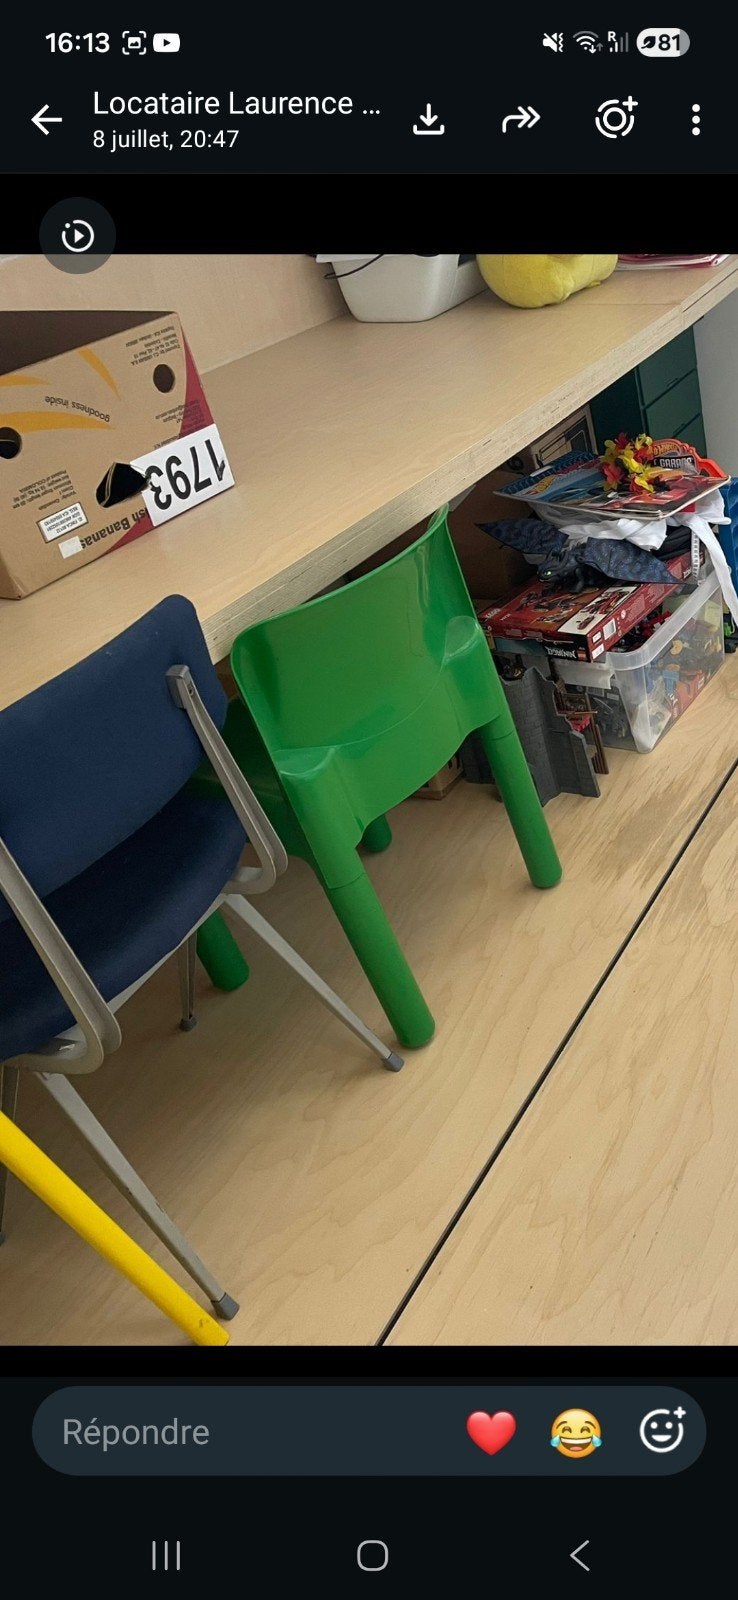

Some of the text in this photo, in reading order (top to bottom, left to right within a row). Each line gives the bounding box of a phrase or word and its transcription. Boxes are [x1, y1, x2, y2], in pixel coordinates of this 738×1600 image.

[45, 396, 111, 422] goodness inside
[145, 439, 226, 511] 1793
[81, 517, 131, 549] Bananas
